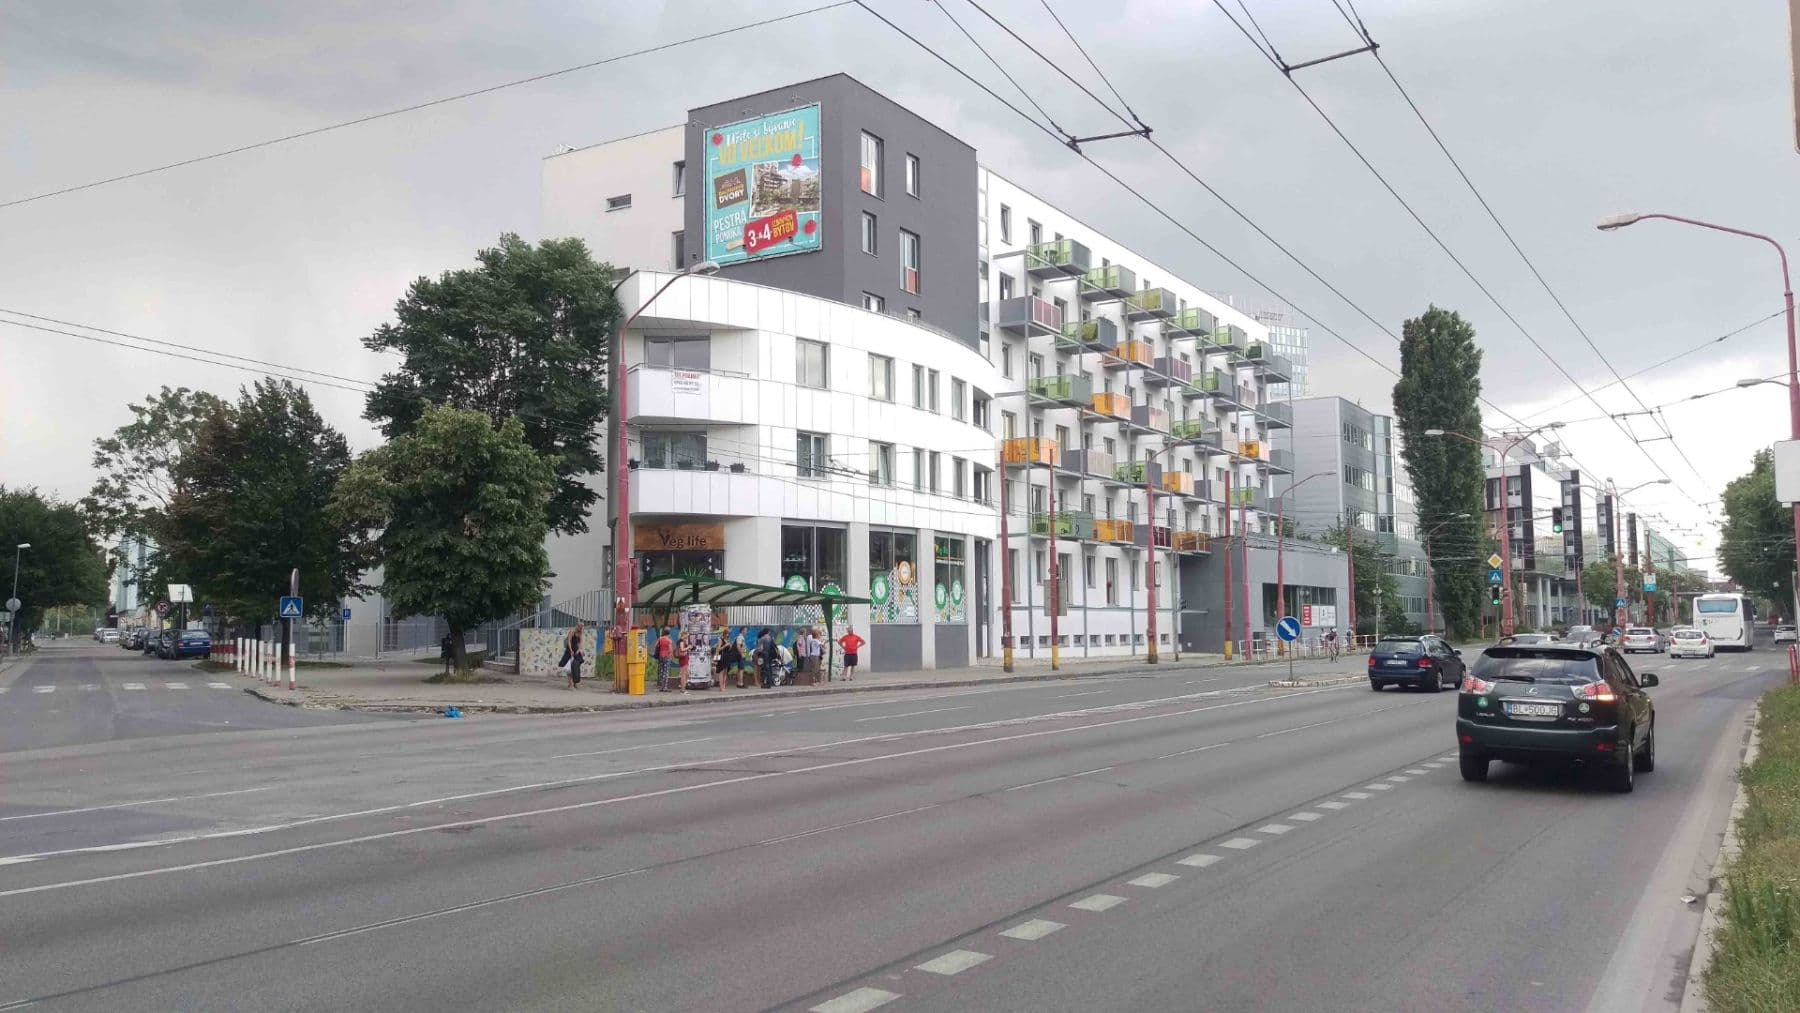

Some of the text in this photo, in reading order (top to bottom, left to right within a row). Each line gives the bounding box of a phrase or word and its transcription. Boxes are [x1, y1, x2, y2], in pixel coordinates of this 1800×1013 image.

[719, 188, 745, 204] DVORY
[713, 207, 747, 233] PESTRÁ
[748, 230, 757, 247] 3
[763, 223, 771, 240] 4
[658, 529, 707, 549] Veg life
